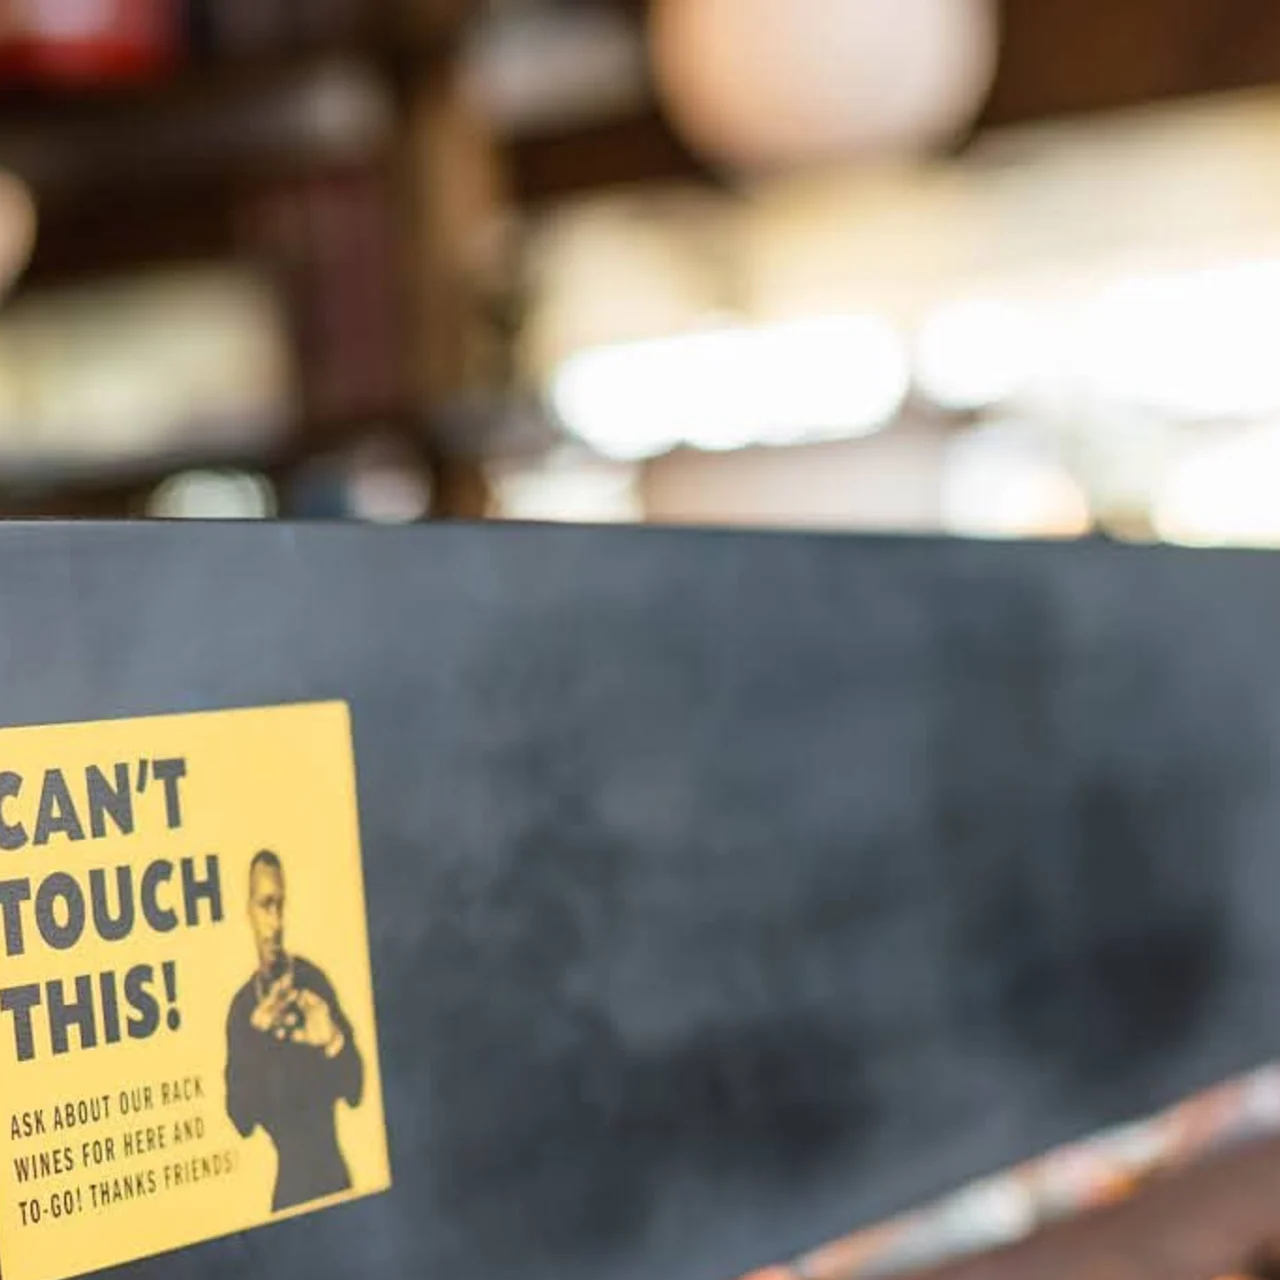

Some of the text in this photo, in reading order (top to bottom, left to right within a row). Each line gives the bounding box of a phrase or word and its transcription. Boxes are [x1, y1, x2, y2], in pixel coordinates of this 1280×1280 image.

[11, 1077, 205, 1140] ASK ABOUT OUR RACK
[13, 1116, 205, 1183] WINES FOR HERE AND
[18, 1188, 82, 1226] TO-GO!
[89, 1169, 156, 1208] THANKS
